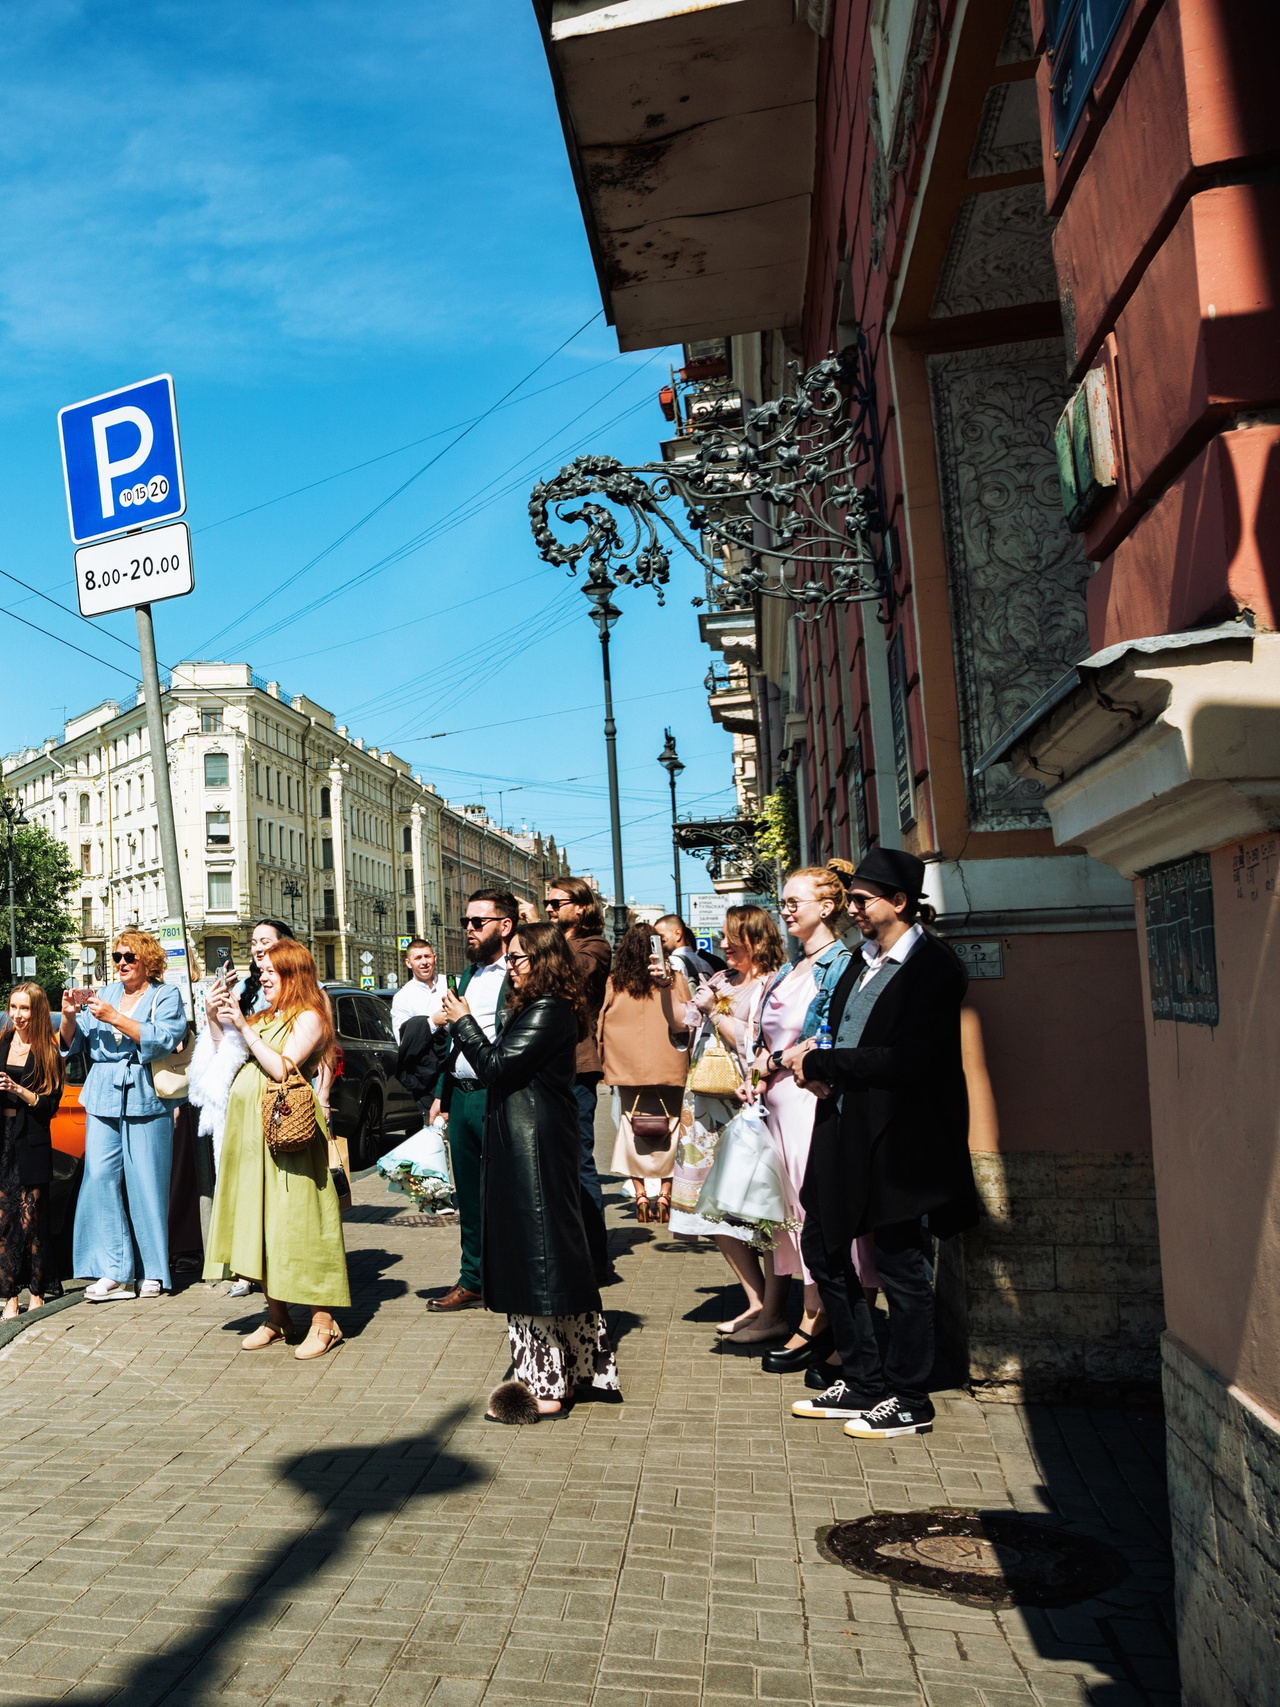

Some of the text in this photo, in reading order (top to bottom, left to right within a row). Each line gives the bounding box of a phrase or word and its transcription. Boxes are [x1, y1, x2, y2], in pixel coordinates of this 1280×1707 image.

[91, 405, 154, 519] P
[122, 479, 169, 503] 10 15 20
[84, 554, 180, 590] 8.00-20.00
[161, 927, 181, 938] 7801
